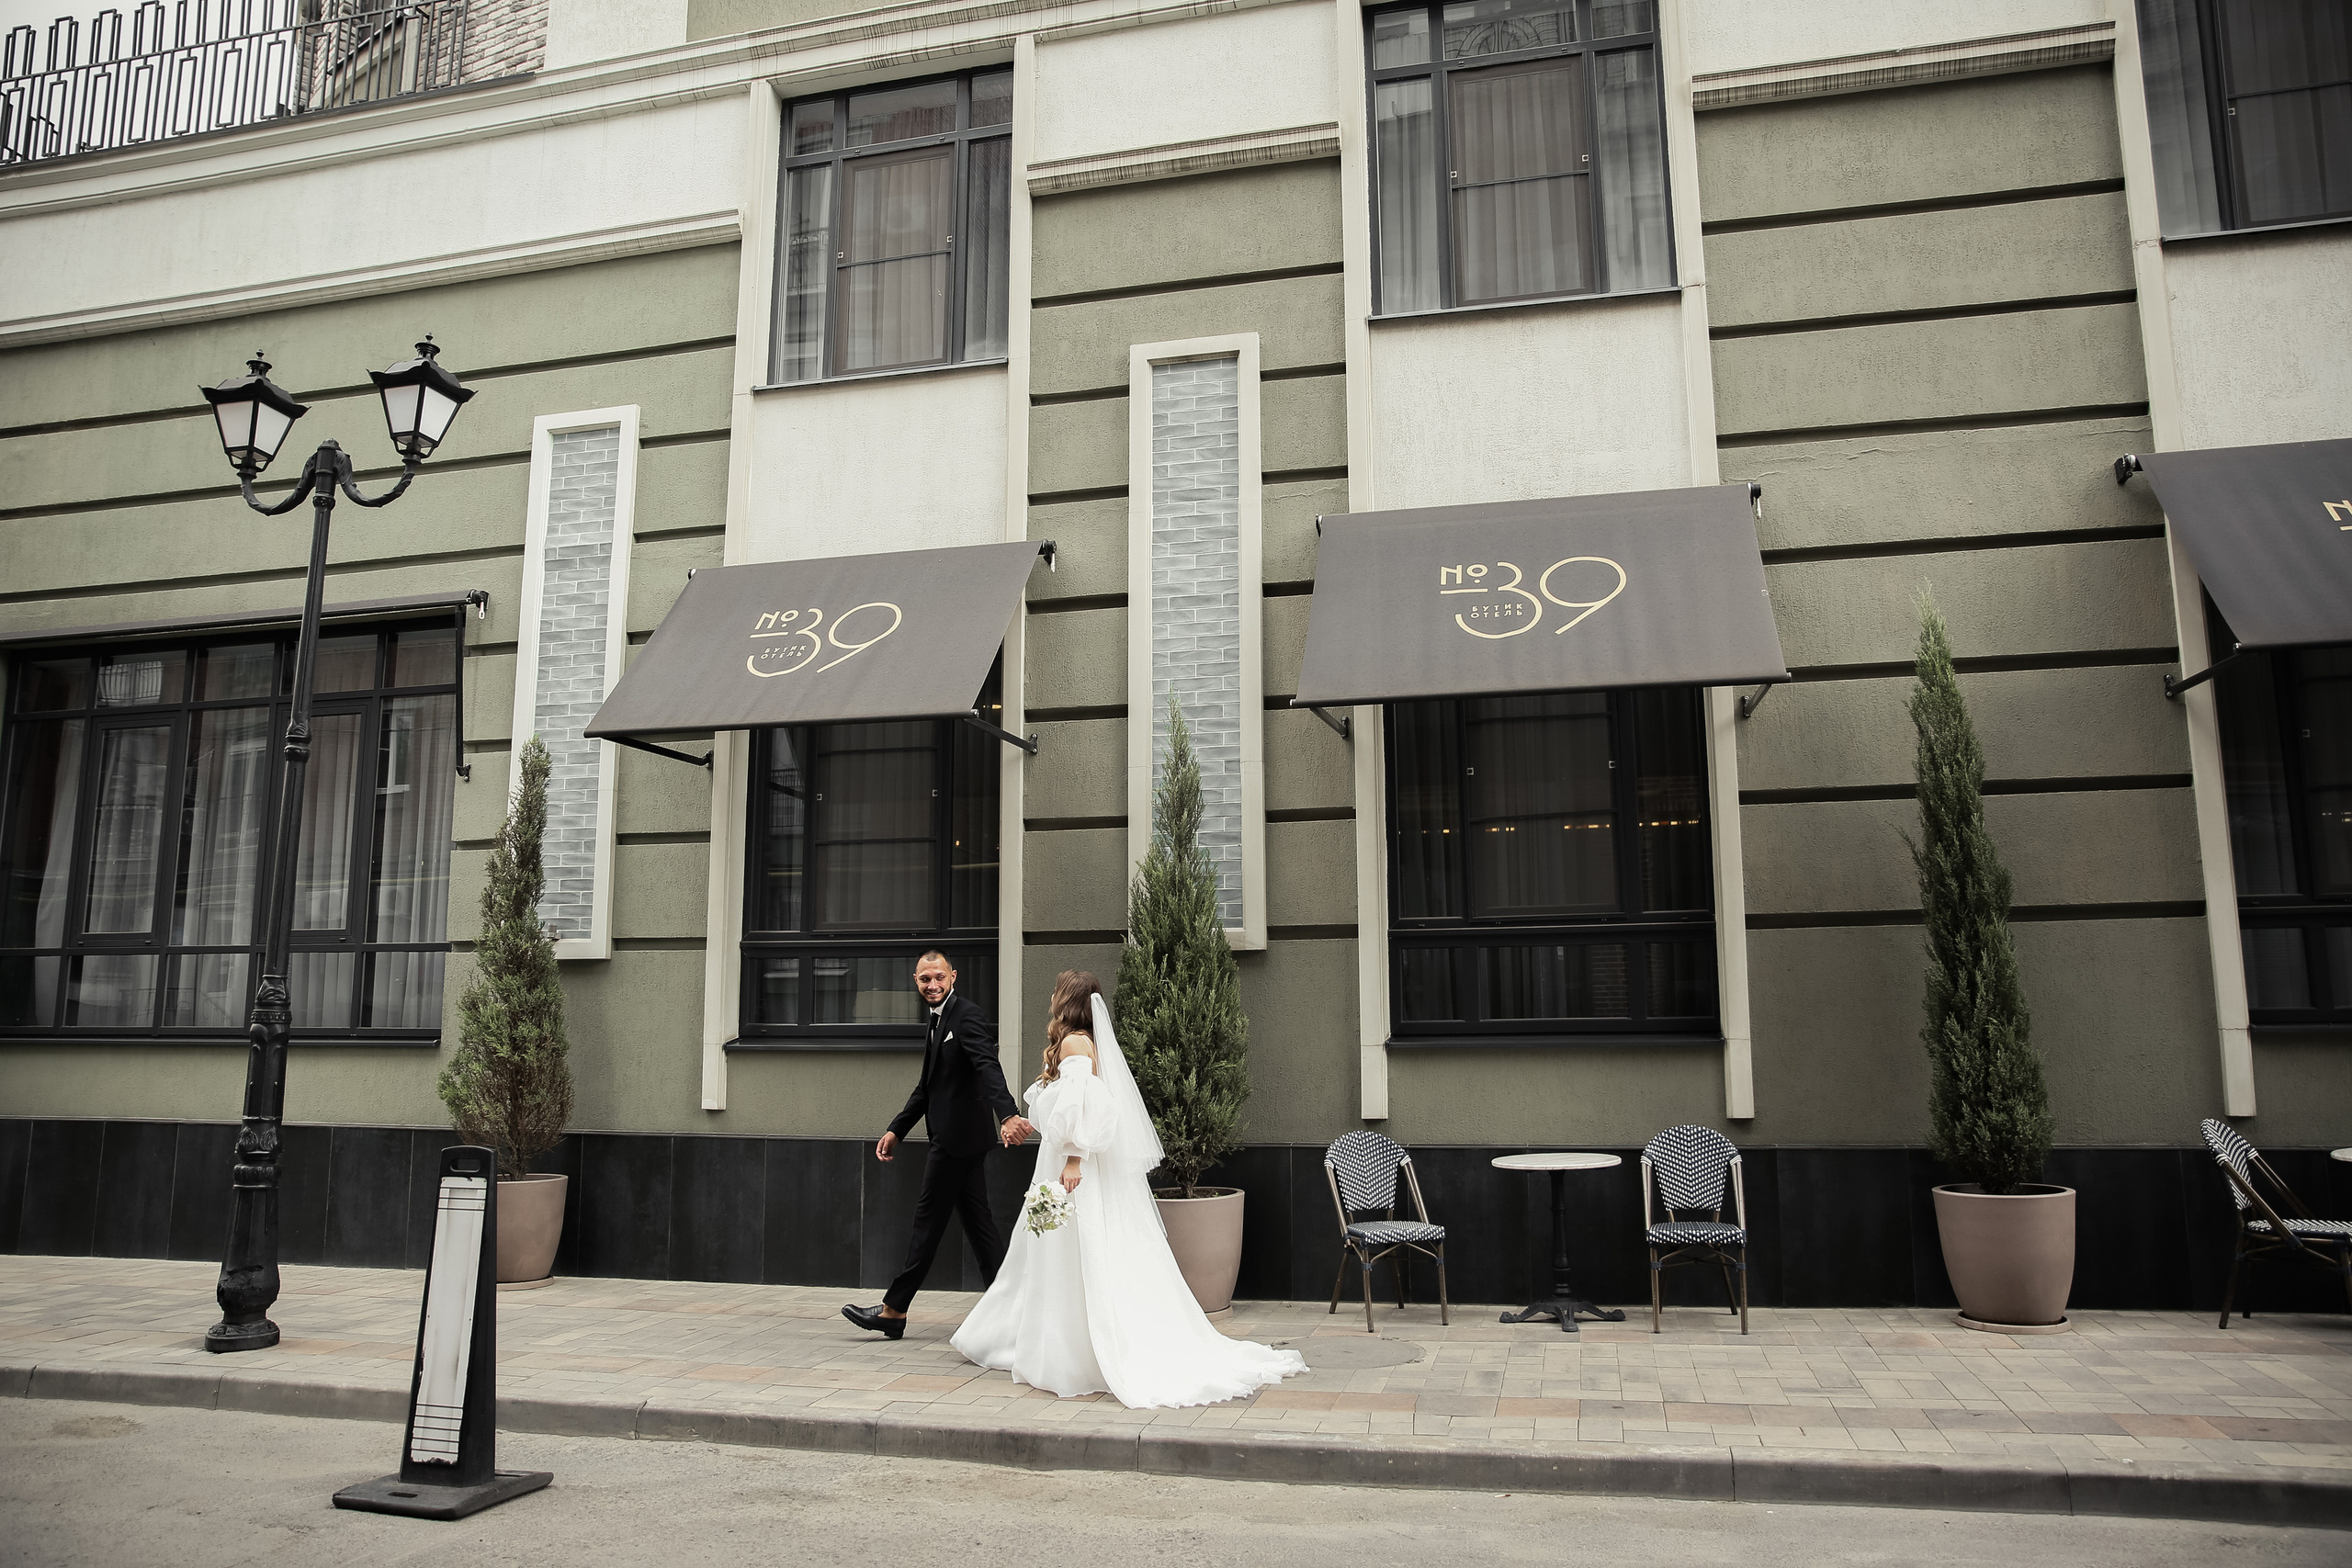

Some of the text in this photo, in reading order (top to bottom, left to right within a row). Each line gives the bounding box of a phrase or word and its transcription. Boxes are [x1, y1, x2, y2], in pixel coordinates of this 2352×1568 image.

[2322, 499, 2352, 522] N
[1455, 556, 1627, 639] 39
[1472, 603, 1523, 613] БУТИК
[1470, 610, 1523, 618] ОТЕЛЬ
[746, 602, 902, 678] 39
[763, 645, 808, 654] БУТИК
[760, 651, 803, 660] ОТЕЛЬ
